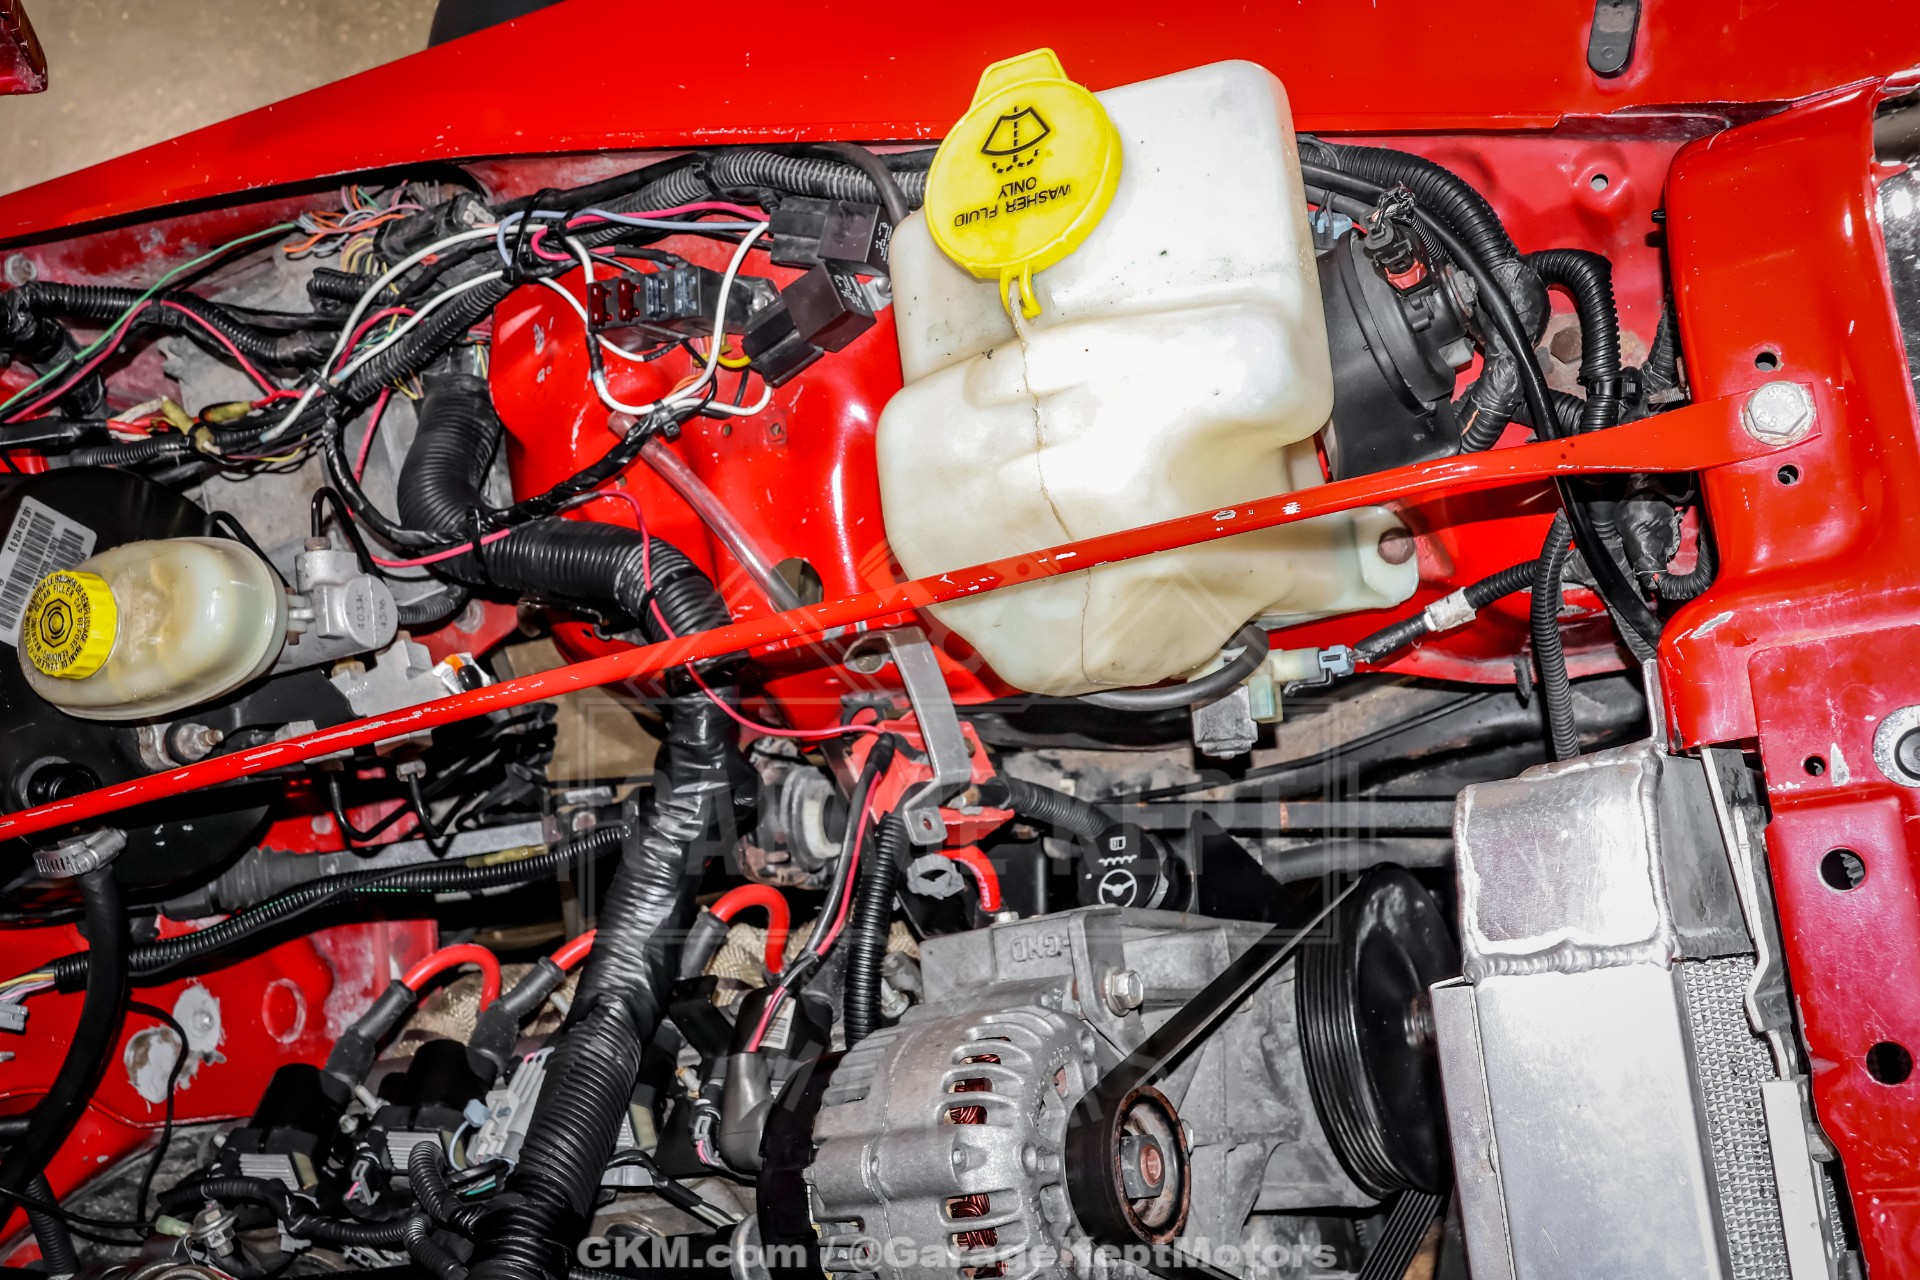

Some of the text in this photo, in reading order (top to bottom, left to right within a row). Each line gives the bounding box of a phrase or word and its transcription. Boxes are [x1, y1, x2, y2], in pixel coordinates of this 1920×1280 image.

[997, 176, 1038, 200] ONLY
[954, 184, 1071, 227] WASHER FLUID
[53, 584, 74, 598] FILLER
[74, 598, 83, 613] CAP
[70, 617, 84, 650] BEFORE
